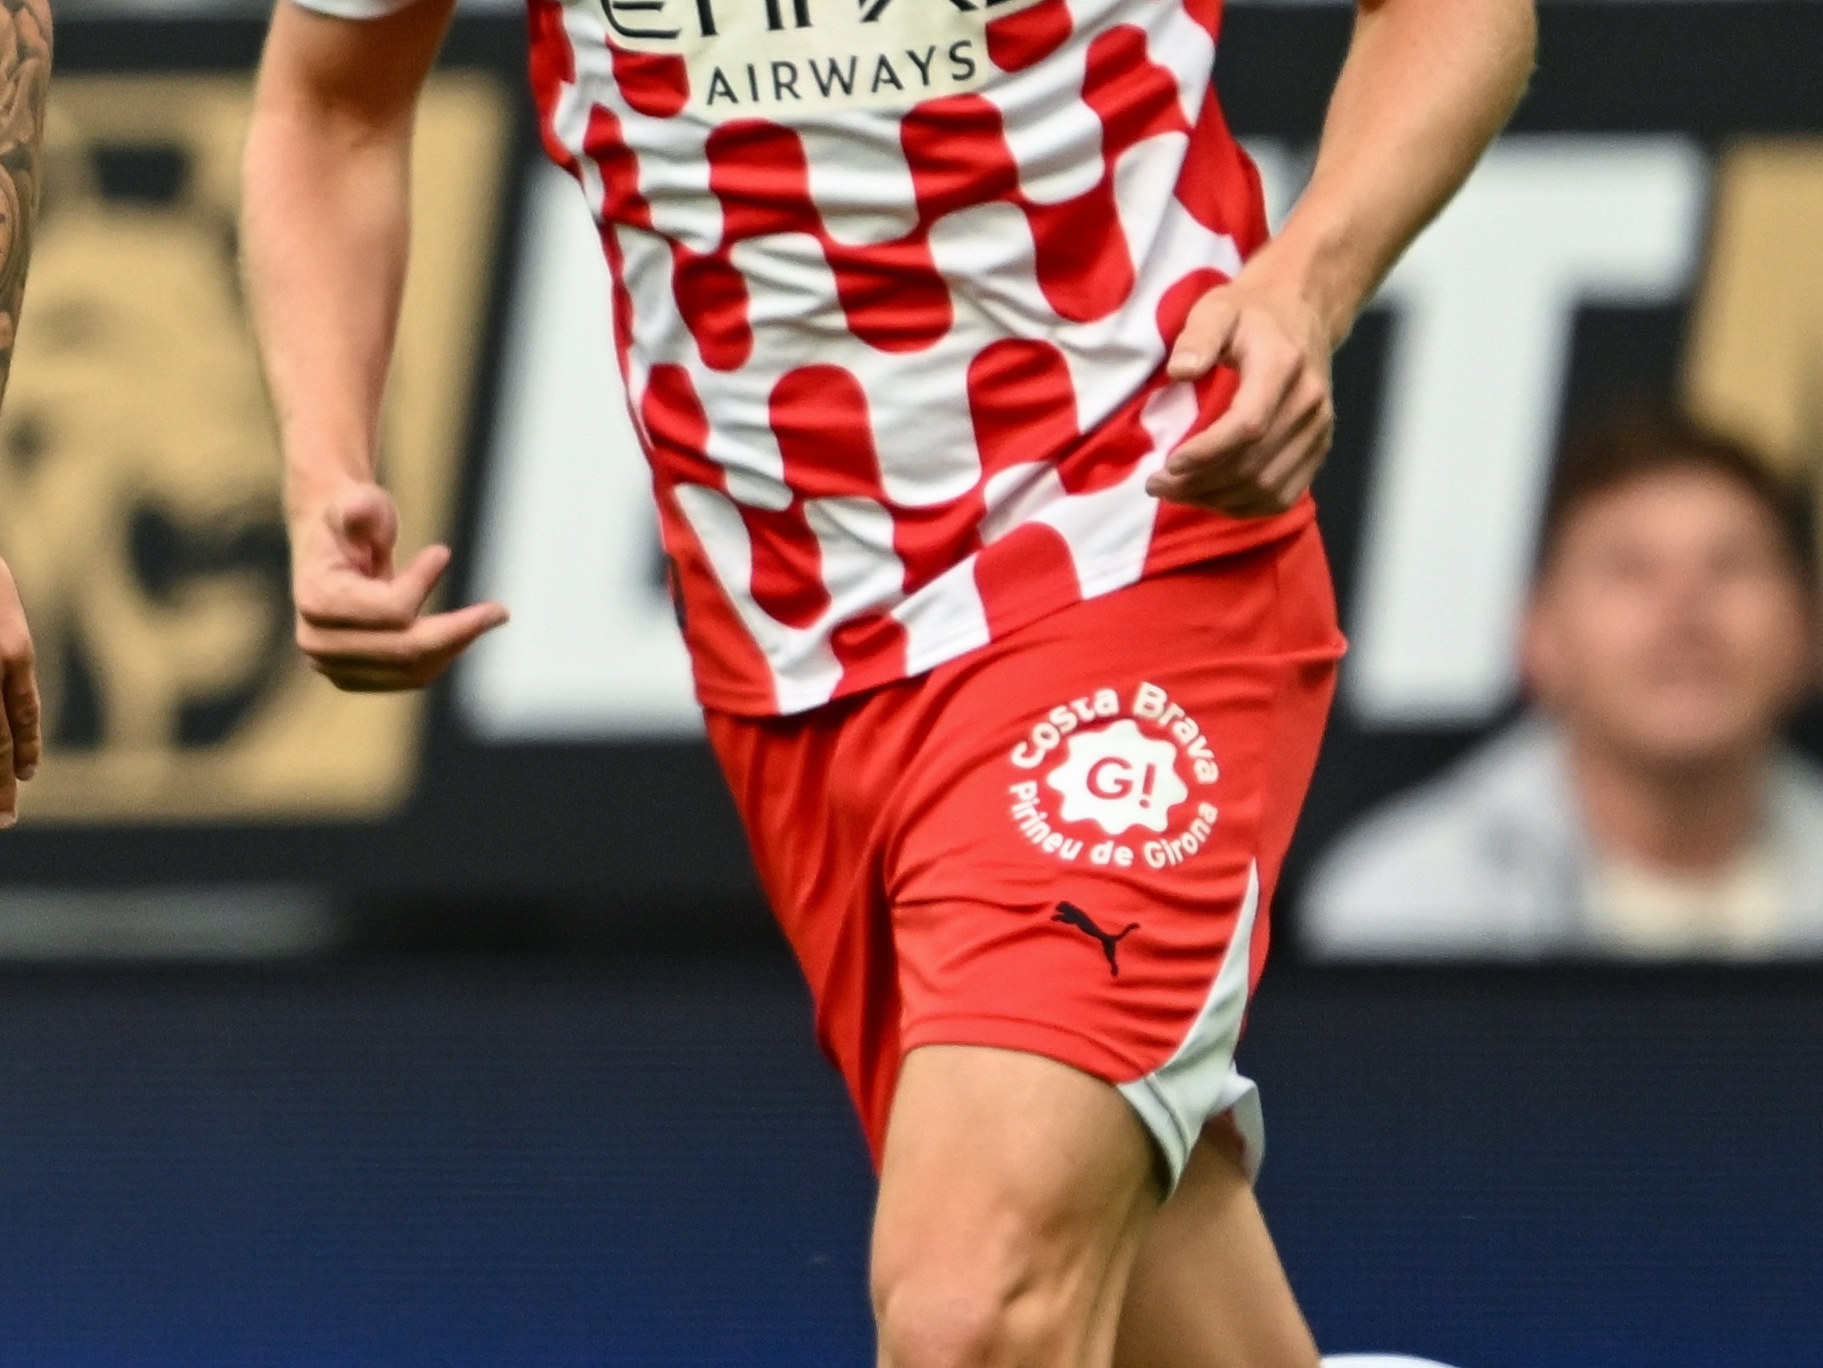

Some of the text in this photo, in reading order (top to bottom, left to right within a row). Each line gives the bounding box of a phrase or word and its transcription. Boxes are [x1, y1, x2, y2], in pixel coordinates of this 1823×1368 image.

[707, 39, 977, 107] AIRWAYS
[1009, 680, 1220, 785] Costa Brava
[1085, 755, 1157, 810] G!
[1009, 781, 1219, 870] Pirineu de Girona
